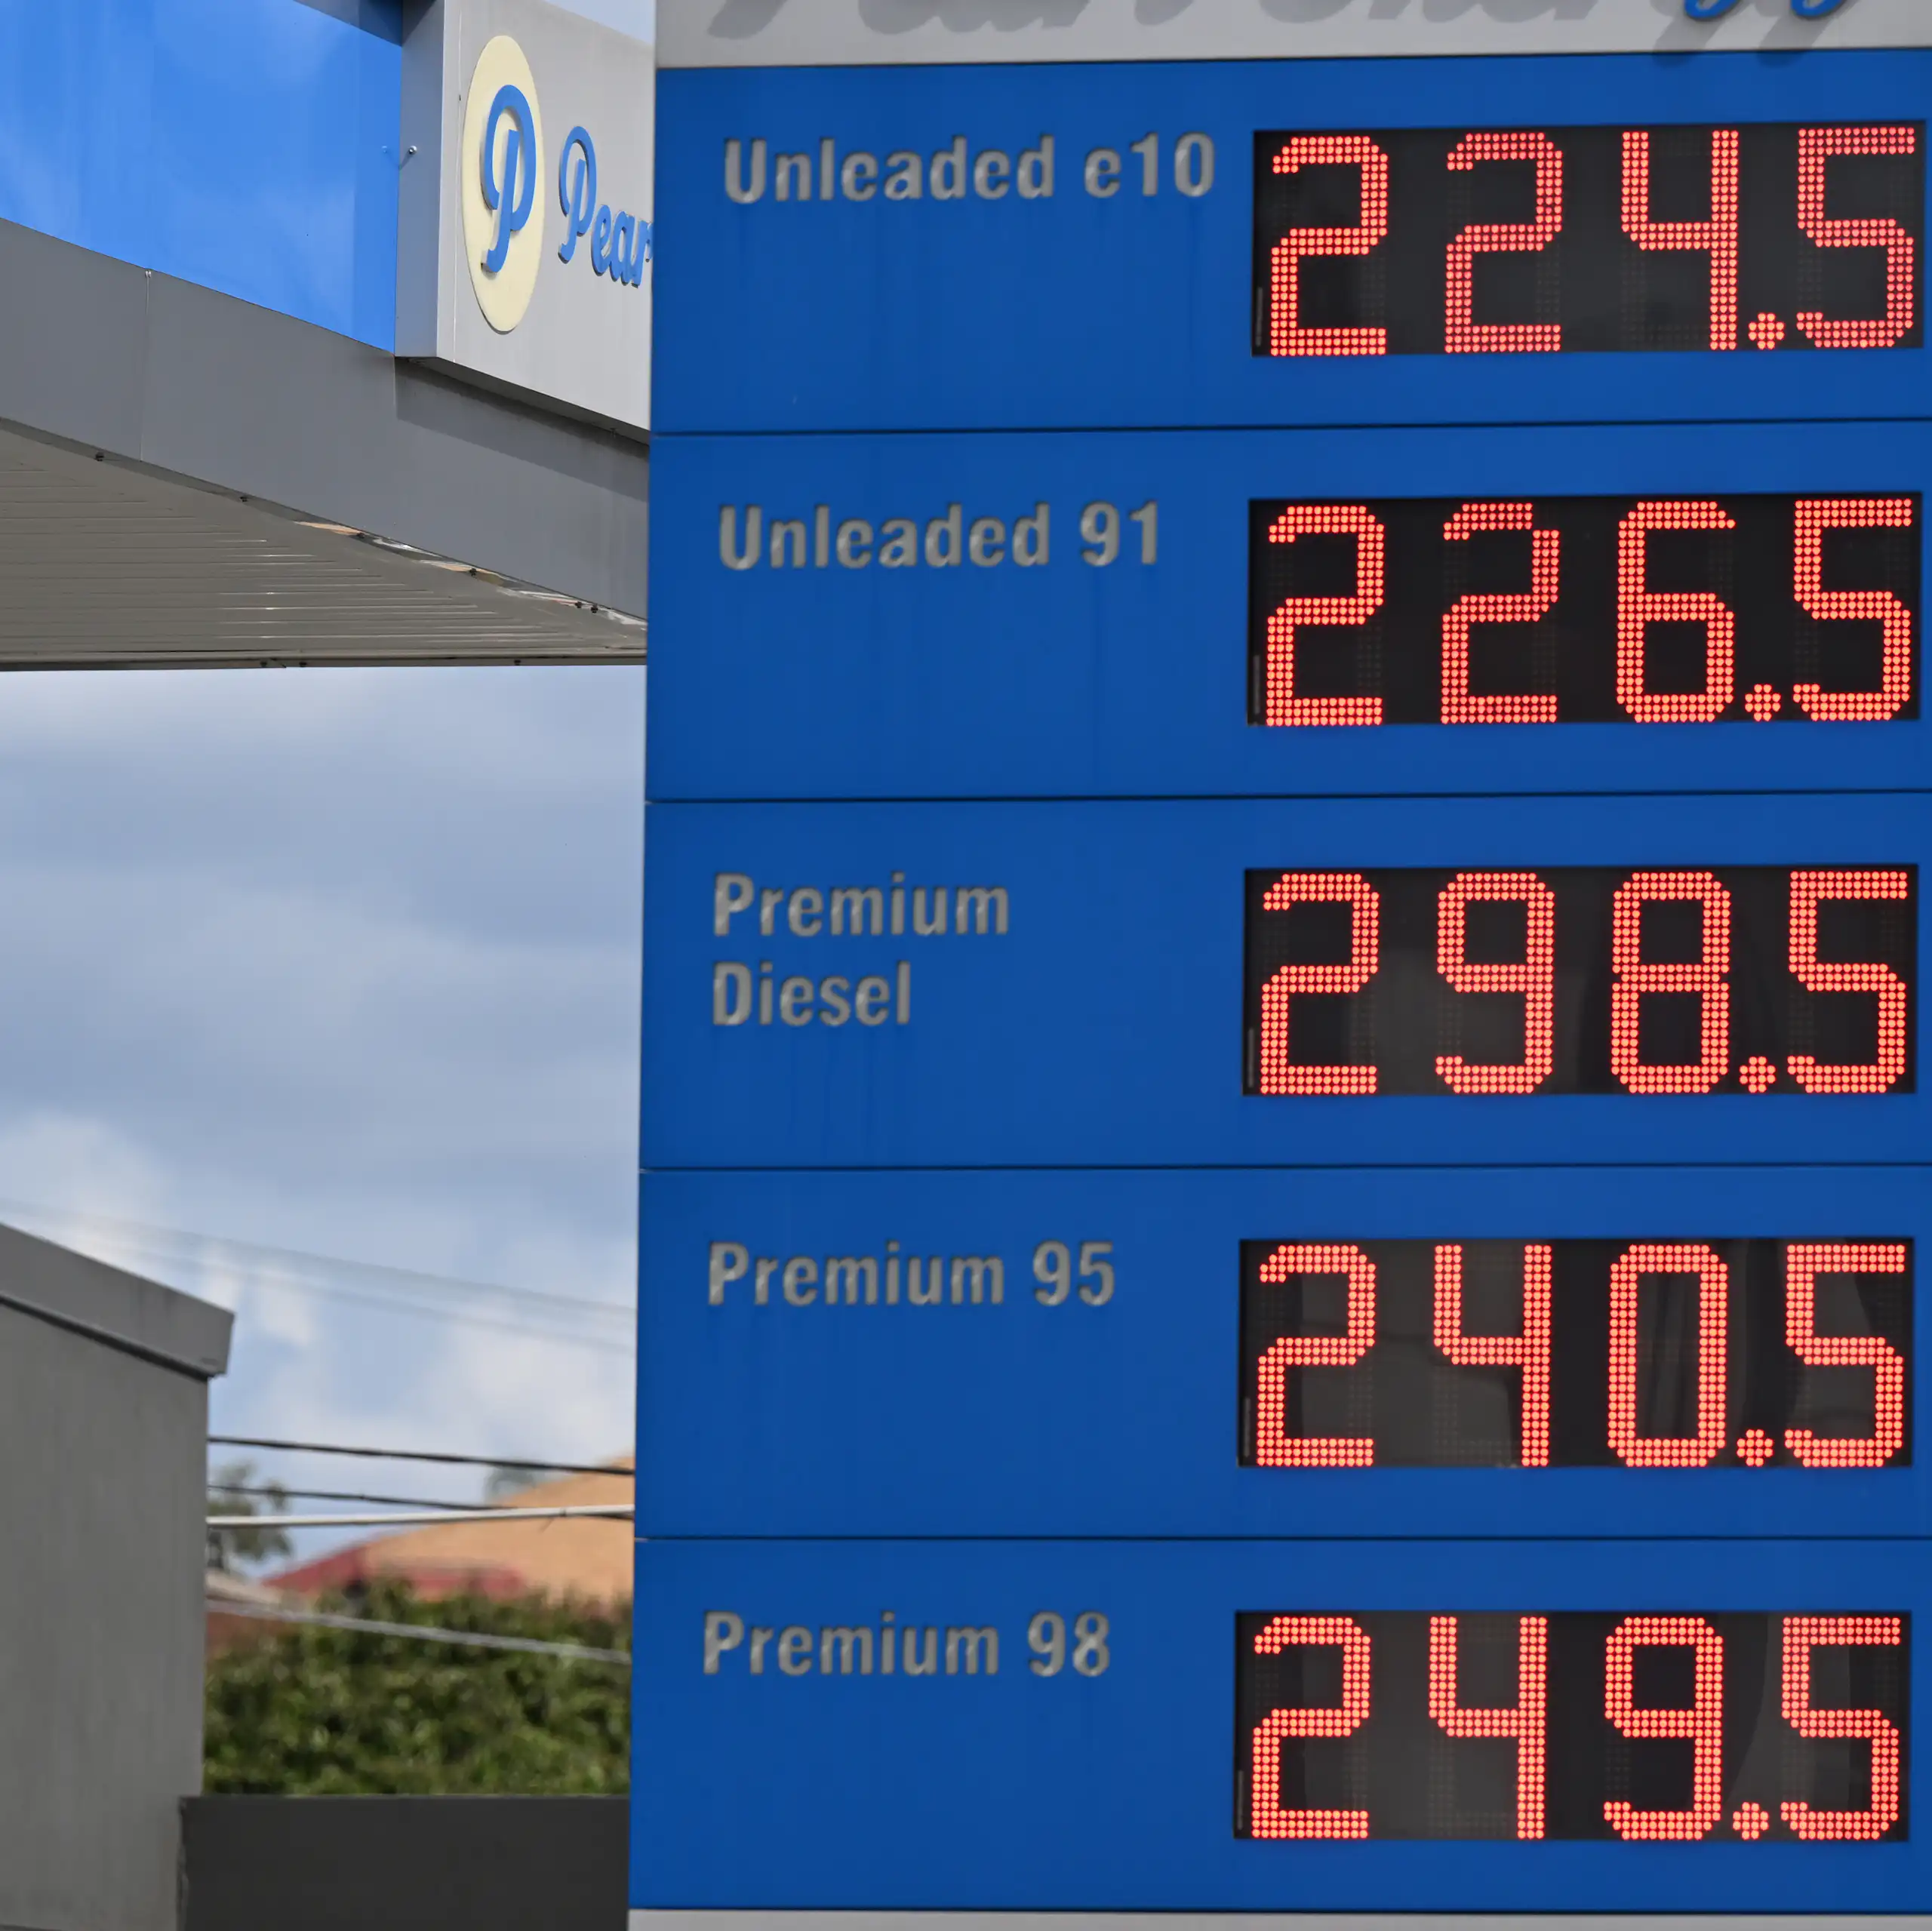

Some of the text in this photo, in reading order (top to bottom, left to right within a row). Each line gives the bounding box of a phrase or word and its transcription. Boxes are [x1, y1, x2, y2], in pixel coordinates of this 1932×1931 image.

[724, 132, 1215, 204] Unleaded e10
[1270, 126, 1915, 357] 224.5
[718, 501, 1158, 570] Unleaded 91
[1266, 498, 1912, 727] 226.5
[712, 872, 1010, 938] Premium
[712, 961, 912, 1027] Diesel
[1260, 871, 1908, 1095] 298.5
[707, 1241, 1114, 1306] Premium 95
[1257, 1243, 1906, 1468] 240.5
[702, 1611, 1111, 1677] Premium 98
[1251, 1615, 1901, 1840] 249.5
